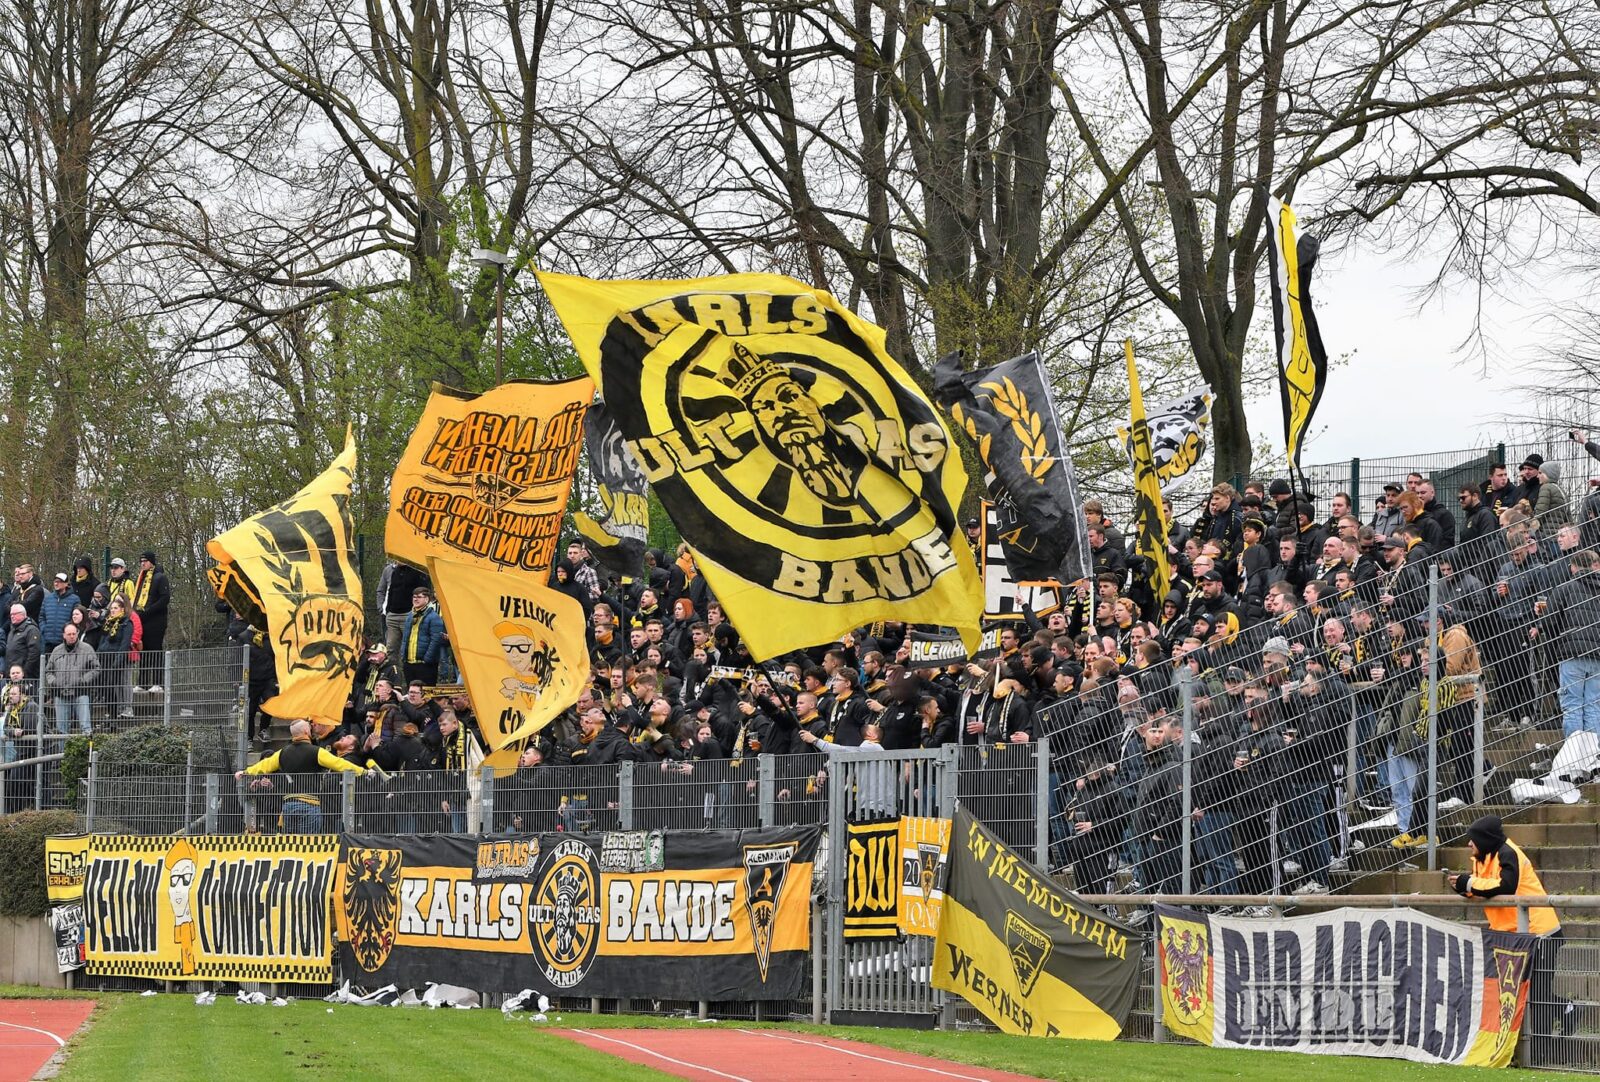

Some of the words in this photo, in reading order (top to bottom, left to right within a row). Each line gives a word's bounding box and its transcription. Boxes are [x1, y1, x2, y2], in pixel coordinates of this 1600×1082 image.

[625, 411, 744, 484] ULT
[773, 526, 957, 603] BANDE
[477, 841, 530, 868] ULTRAS
[554, 840, 592, 862] KARLS
[84, 859, 163, 953] YELLOW
[198, 859, 332, 957] CONNECTION
[399, 878, 524, 941] KARLS
[605, 881, 737, 943] BANDE
[529, 904, 552, 923] ULT
[578, 906, 600, 924] RAS
[968, 821, 990, 862] IN
[988, 844, 1128, 960] MEMORIAM
[1010, 916, 1046, 949] Alemannia
[545, 964, 584, 986] BANDE
[946, 943, 1033, 1035] WERNER
[1222, 928, 1302, 1047] BAD
[1310, 919, 1474, 1062] AACHEN
